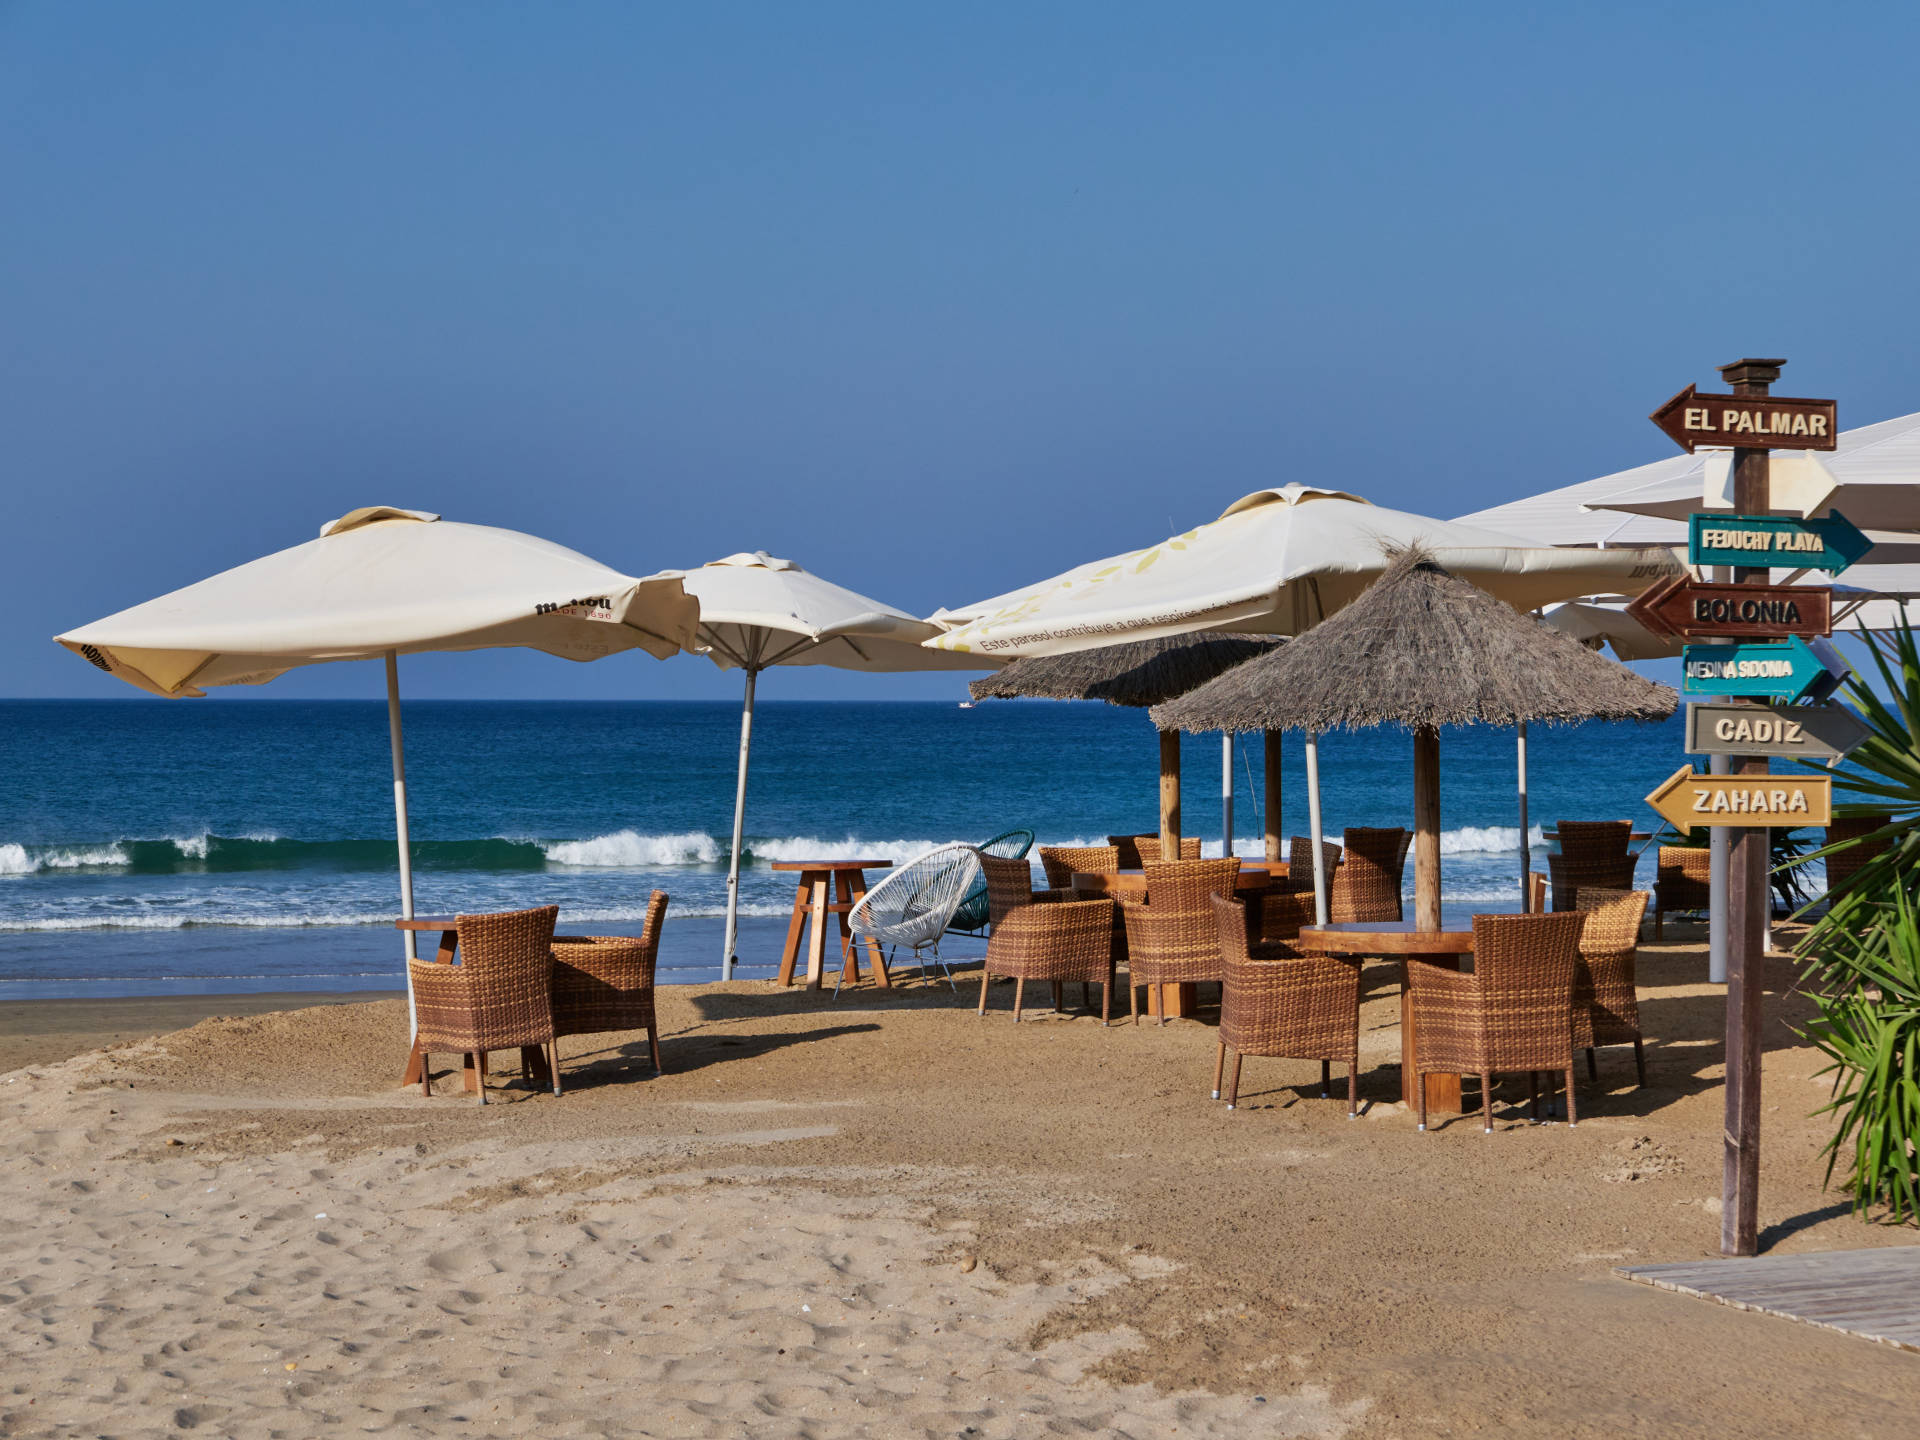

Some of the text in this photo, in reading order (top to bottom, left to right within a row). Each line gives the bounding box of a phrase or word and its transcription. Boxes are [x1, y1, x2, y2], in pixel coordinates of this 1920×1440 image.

[1685, 408, 1827, 437] EL PALMAR
[1702, 529, 1824, 552] FEDUCHY PLAYA
[1694, 599, 1801, 624] BOLONIA
[979, 640, 1010, 651] Este
[1010, 630, 1052, 648] parasol
[1053, 623, 1113, 639] contribuye
[1127, 617, 1151, 629] que
[1687, 660, 1793, 680] MEDINA SIDONIA
[1715, 718, 1804, 743] CADIZ
[1692, 789, 1808, 813] ZAHARA
